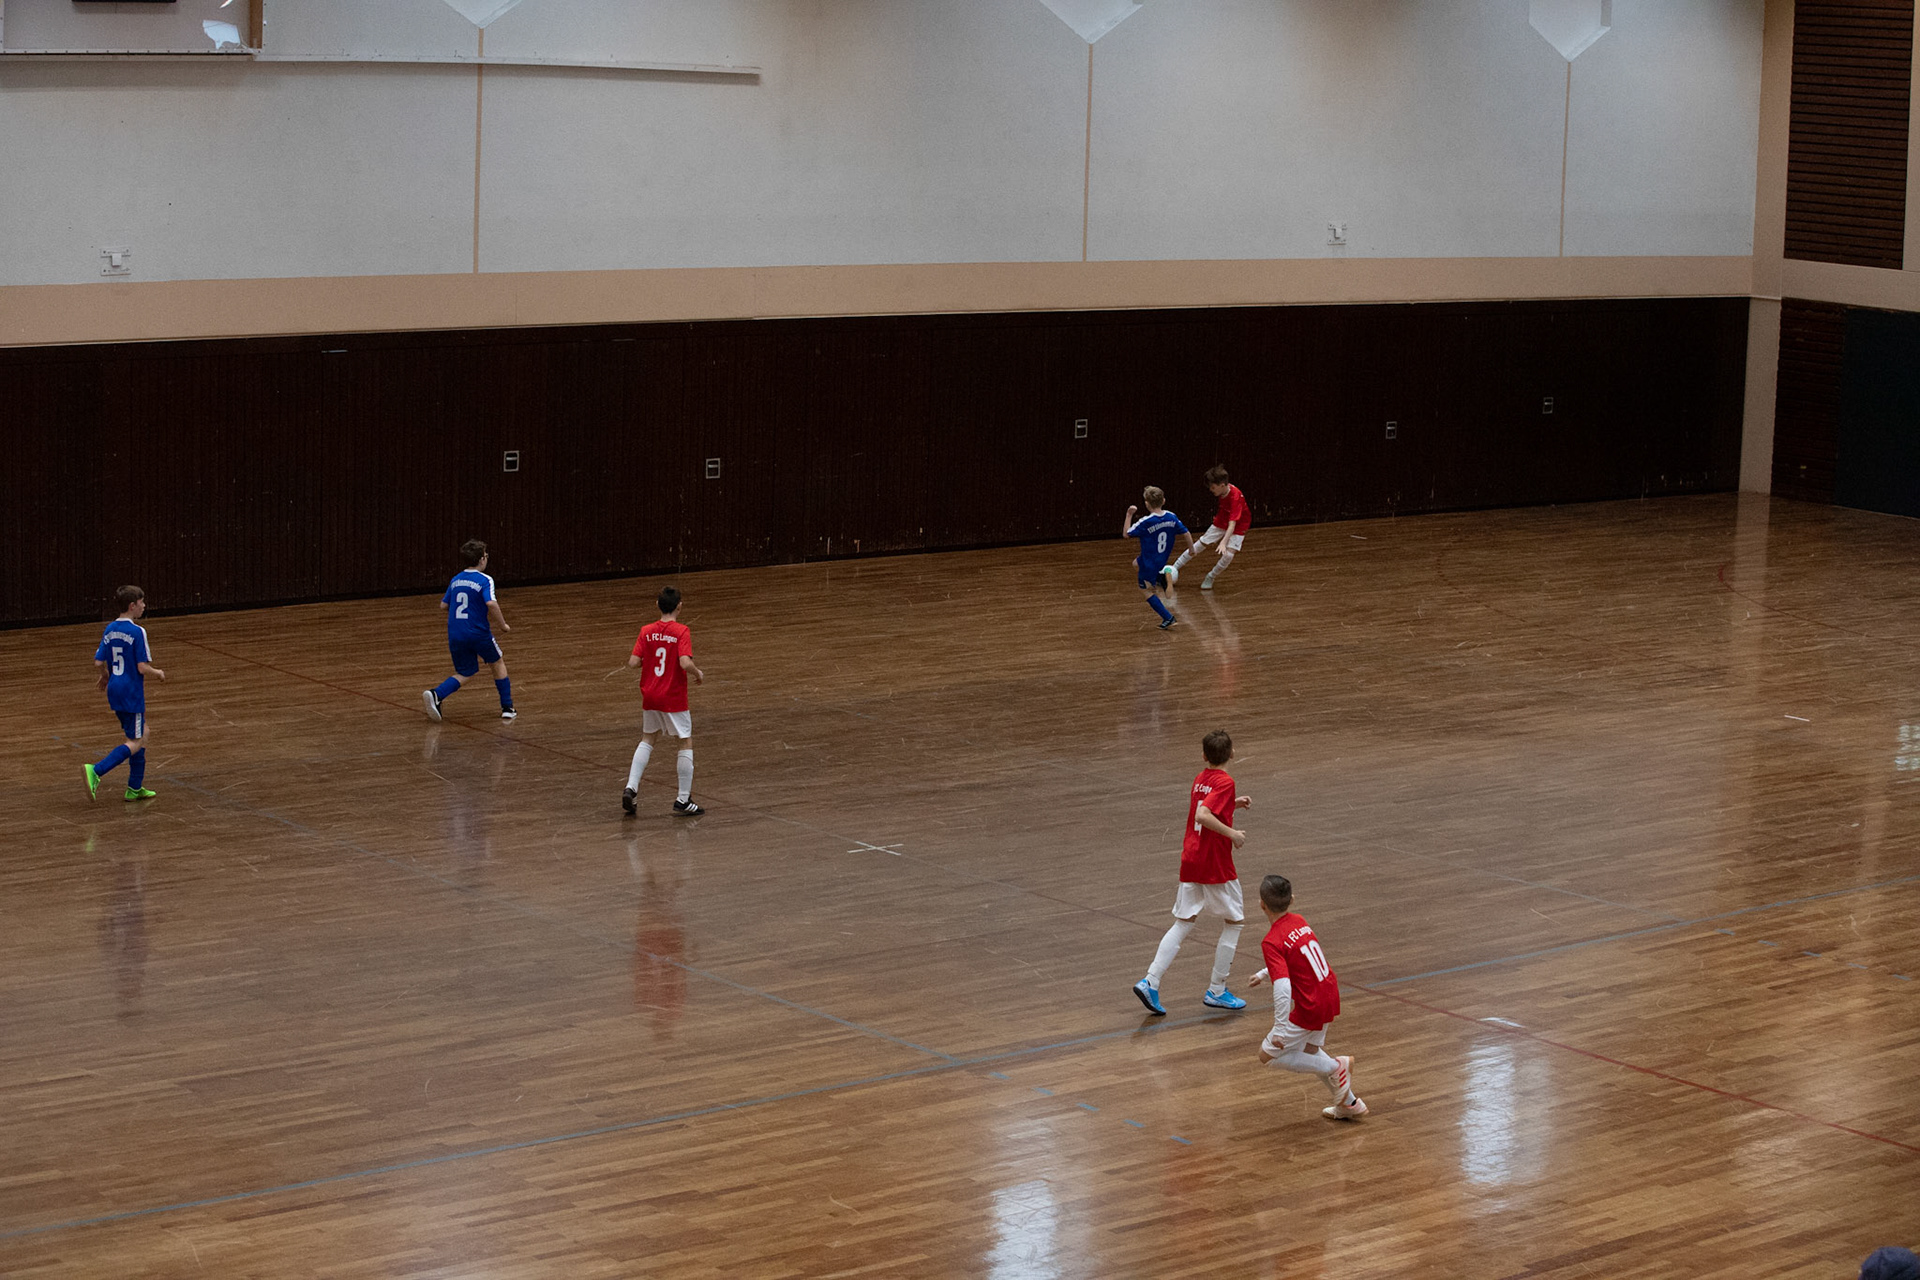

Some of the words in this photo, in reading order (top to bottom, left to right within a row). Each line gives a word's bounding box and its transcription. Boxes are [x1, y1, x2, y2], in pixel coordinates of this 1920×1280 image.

[1157, 531, 1167, 554] 8
[456, 592, 469, 619] 2
[646, 634, 651, 642] 1.
[652, 633, 660, 641] FC
[660, 633, 678, 643] Langen
[112, 647, 125, 676] 5
[654, 647, 667, 677] 3
[1283, 941, 1294, 949] 1.
[1288, 931, 1299, 943] FC
[1300, 940, 1330, 983] 10
